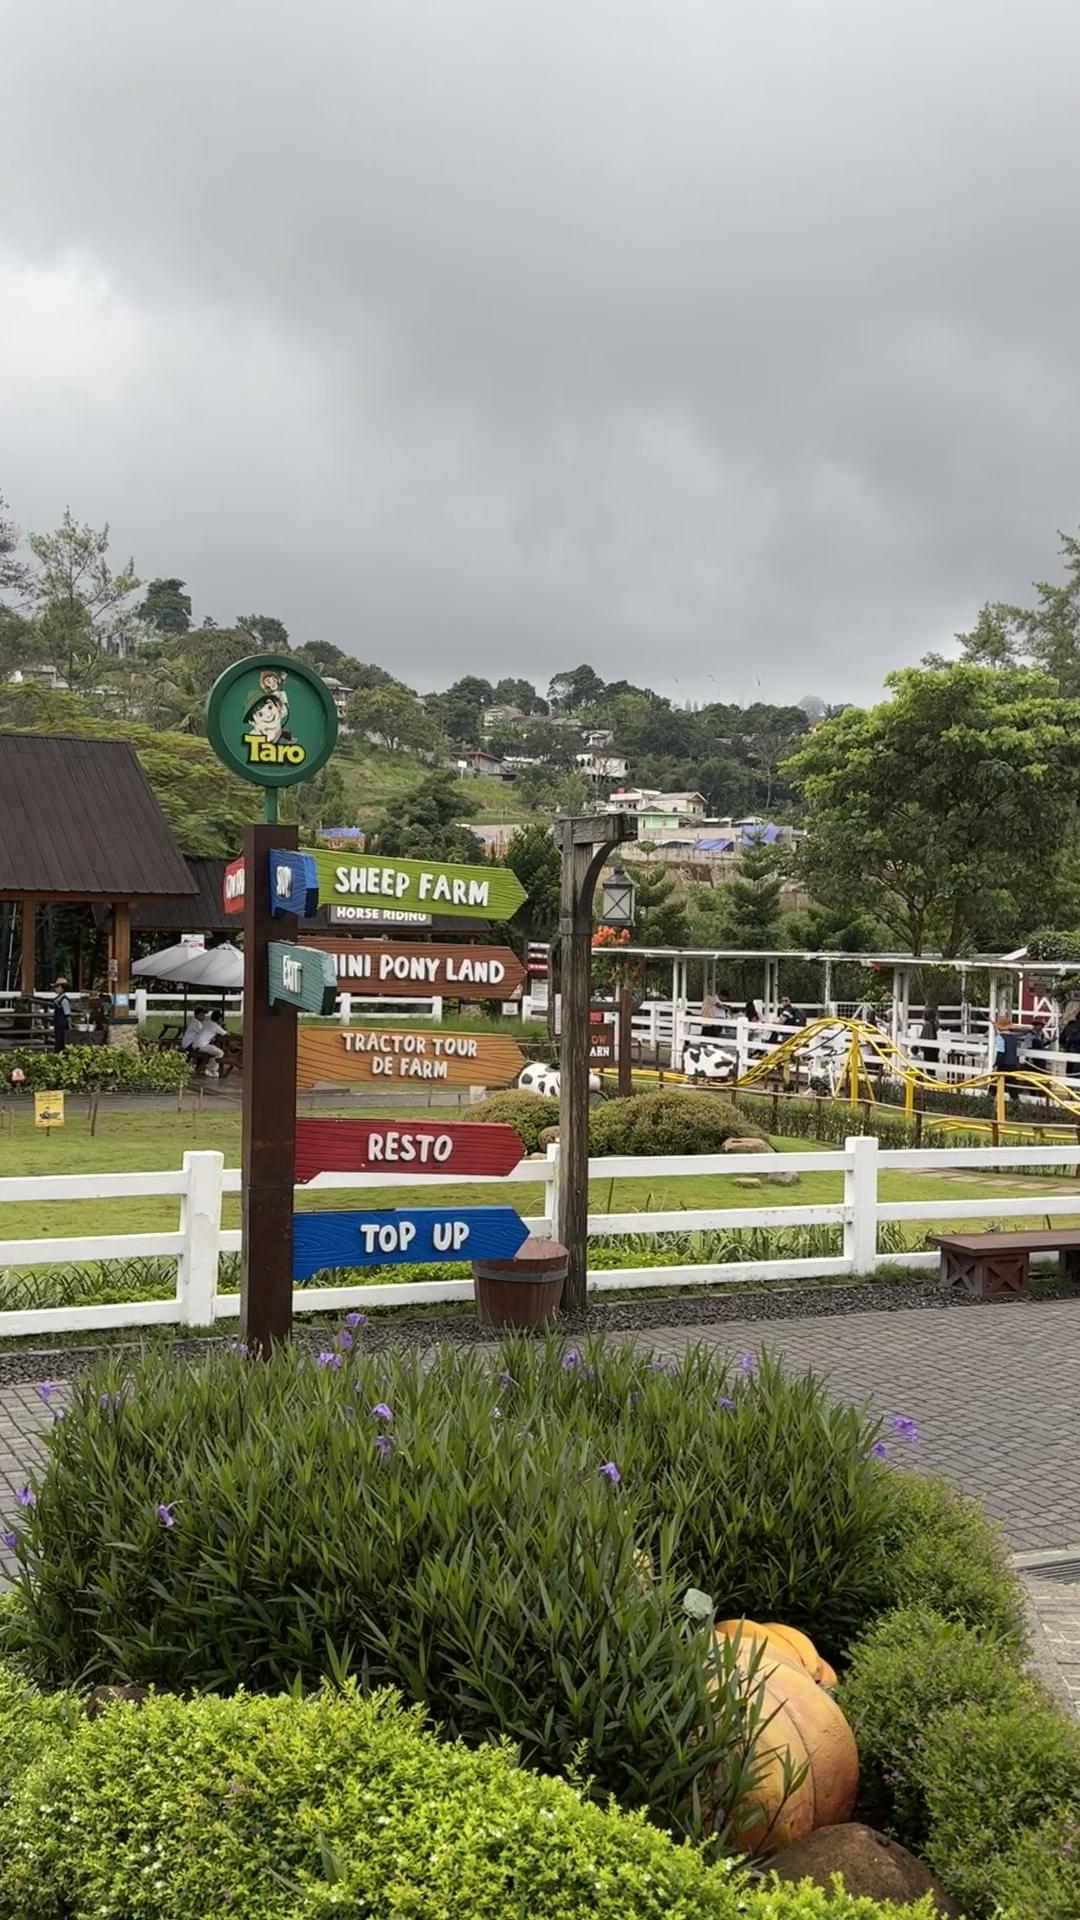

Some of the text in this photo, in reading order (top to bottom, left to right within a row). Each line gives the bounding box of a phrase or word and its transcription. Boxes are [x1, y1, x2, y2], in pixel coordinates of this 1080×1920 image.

[245, 735, 305, 763] Taro
[335, 866, 489, 907] SHEEP FARM
[336, 906, 380, 919] HORSE
[379, 954, 440, 981] PONY
[446, 957, 505, 984] LAND
[341, 1031, 478, 1057] TRACTOR TOUR
[589, 1046, 610, 1056] ARN
[591, 1034, 607, 1045] OW
[371, 1055, 449, 1079] DE FARM
[368, 1131, 454, 1162] RESTO
[360, 1221, 471, 1252] TOP UP
